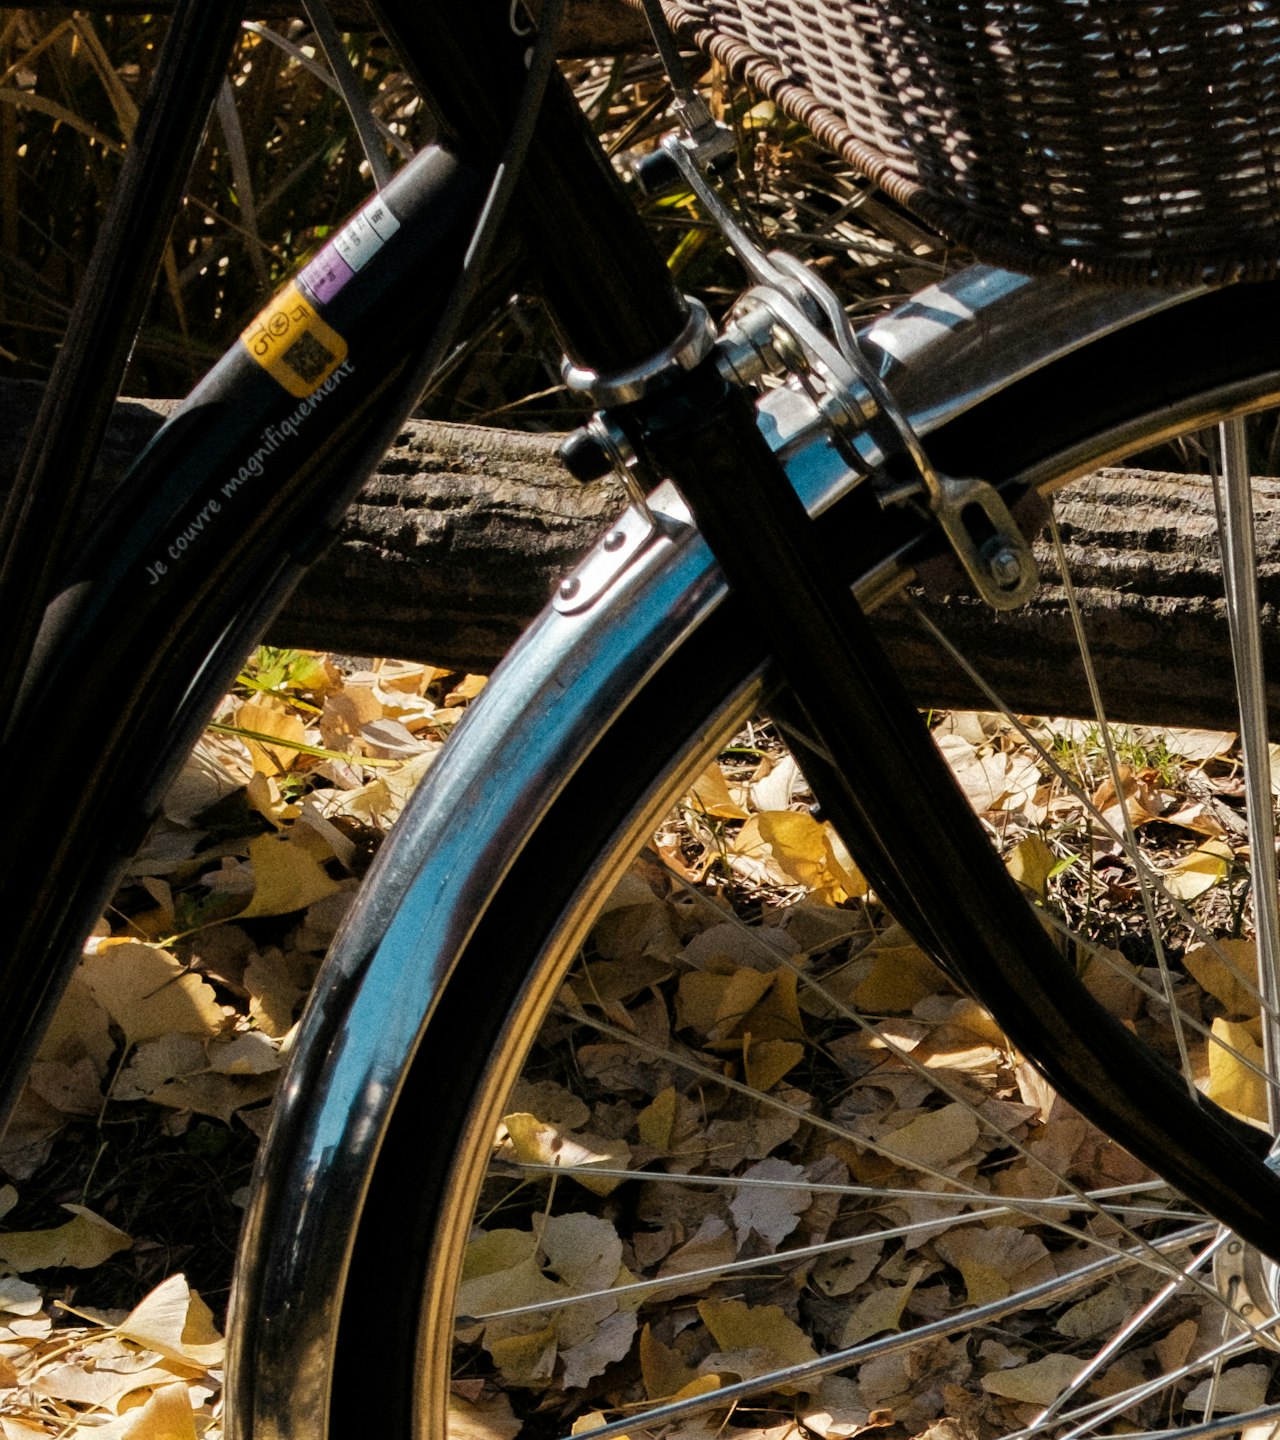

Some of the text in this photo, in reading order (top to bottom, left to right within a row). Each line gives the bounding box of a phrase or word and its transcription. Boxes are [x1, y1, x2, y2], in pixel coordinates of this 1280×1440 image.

[145, 360, 356, 585] Je couvre magnifiquement
